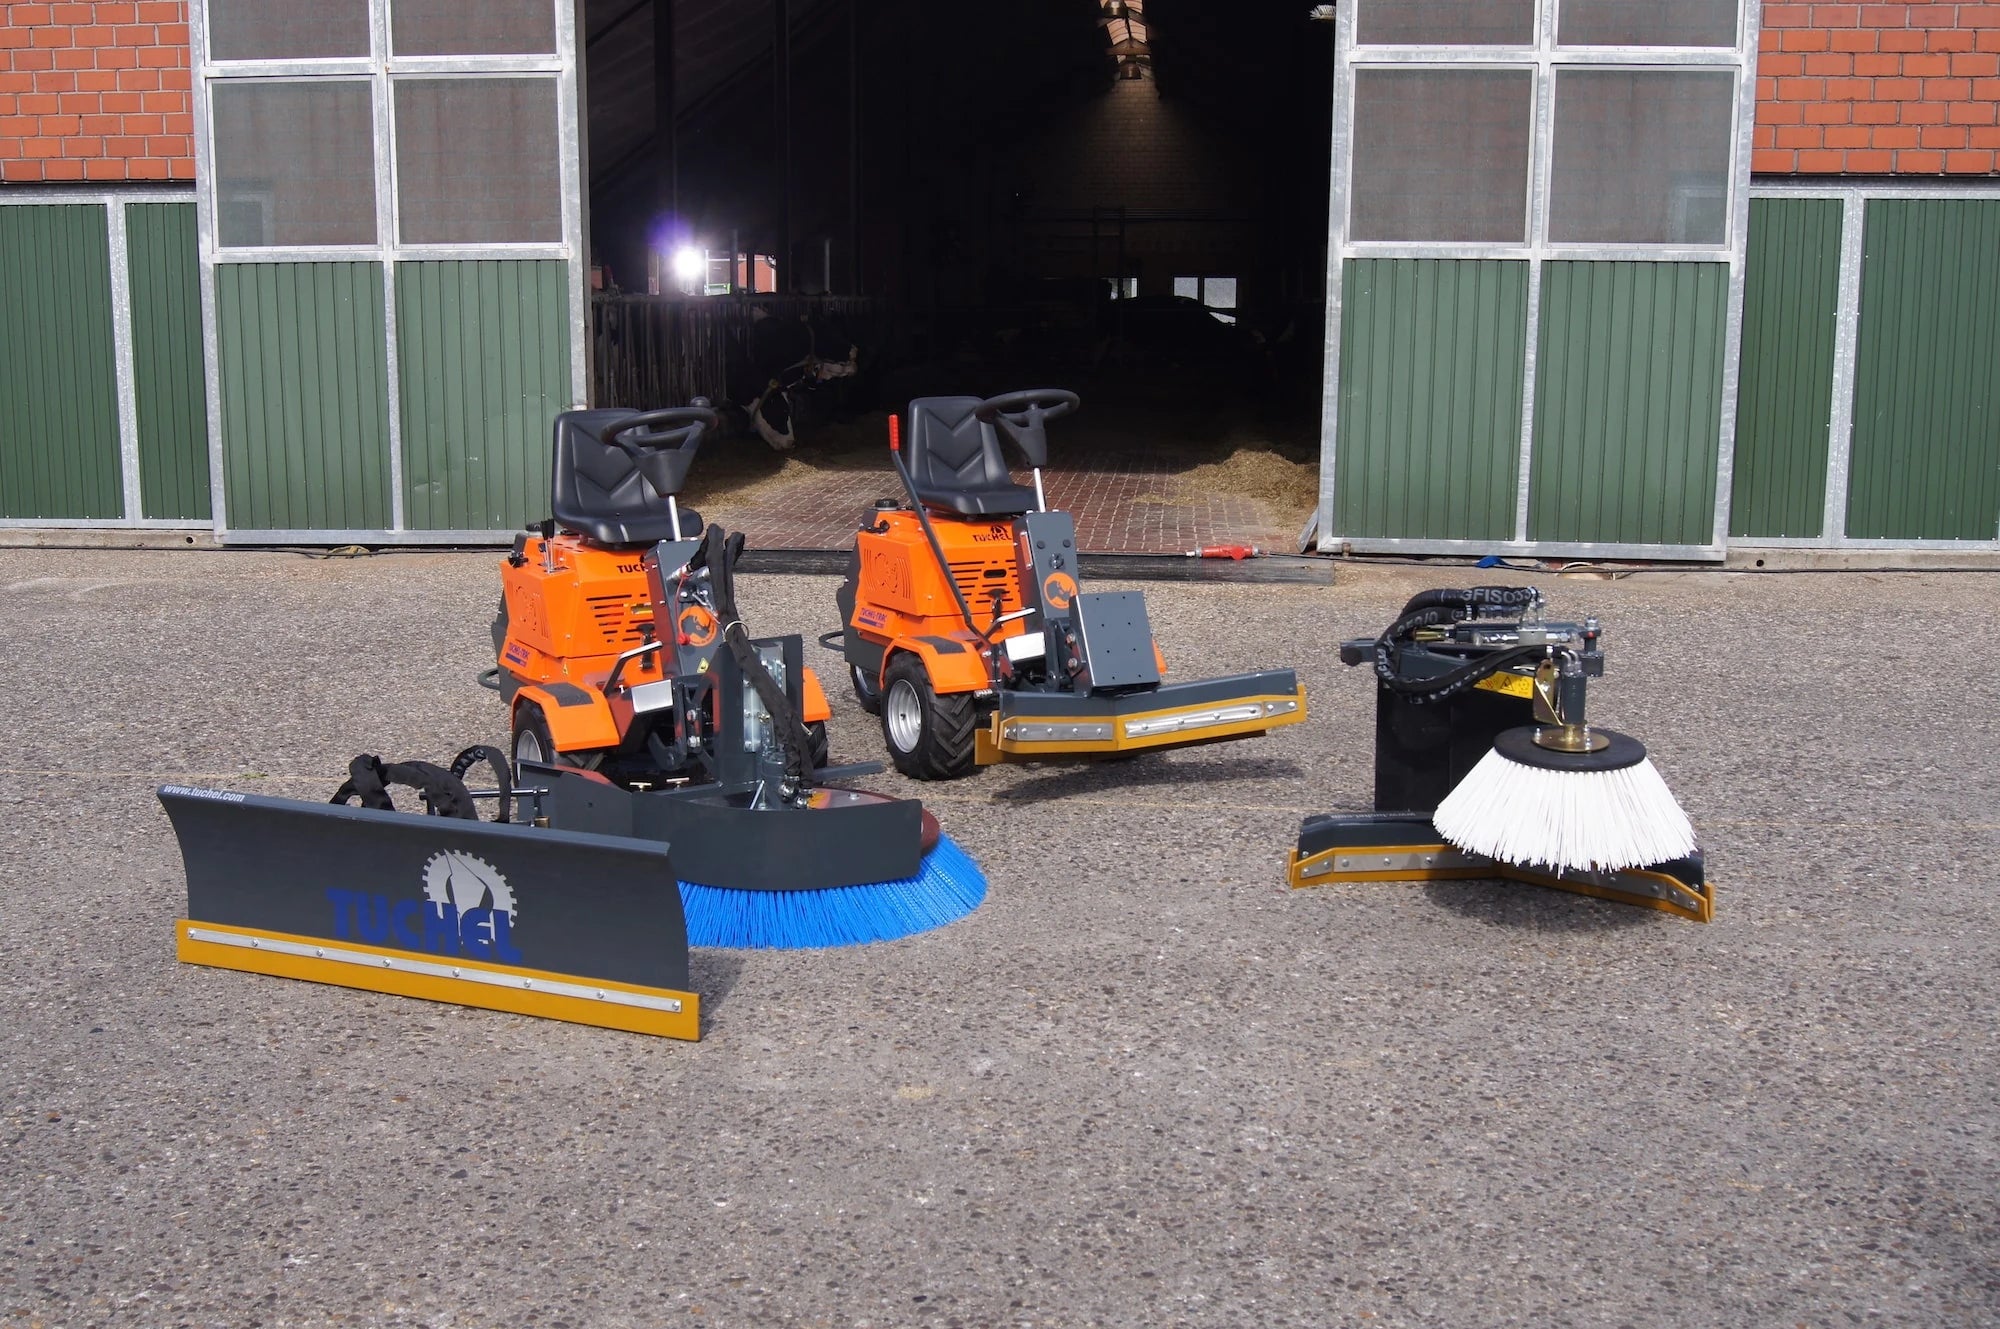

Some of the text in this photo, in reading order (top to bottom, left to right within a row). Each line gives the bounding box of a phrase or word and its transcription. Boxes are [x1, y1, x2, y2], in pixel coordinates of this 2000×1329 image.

[972, 532, 1012, 542] TUCHEL
[163, 784, 246, 802] www.tuchel.com
[325, 886, 522, 965] TUCHEL
